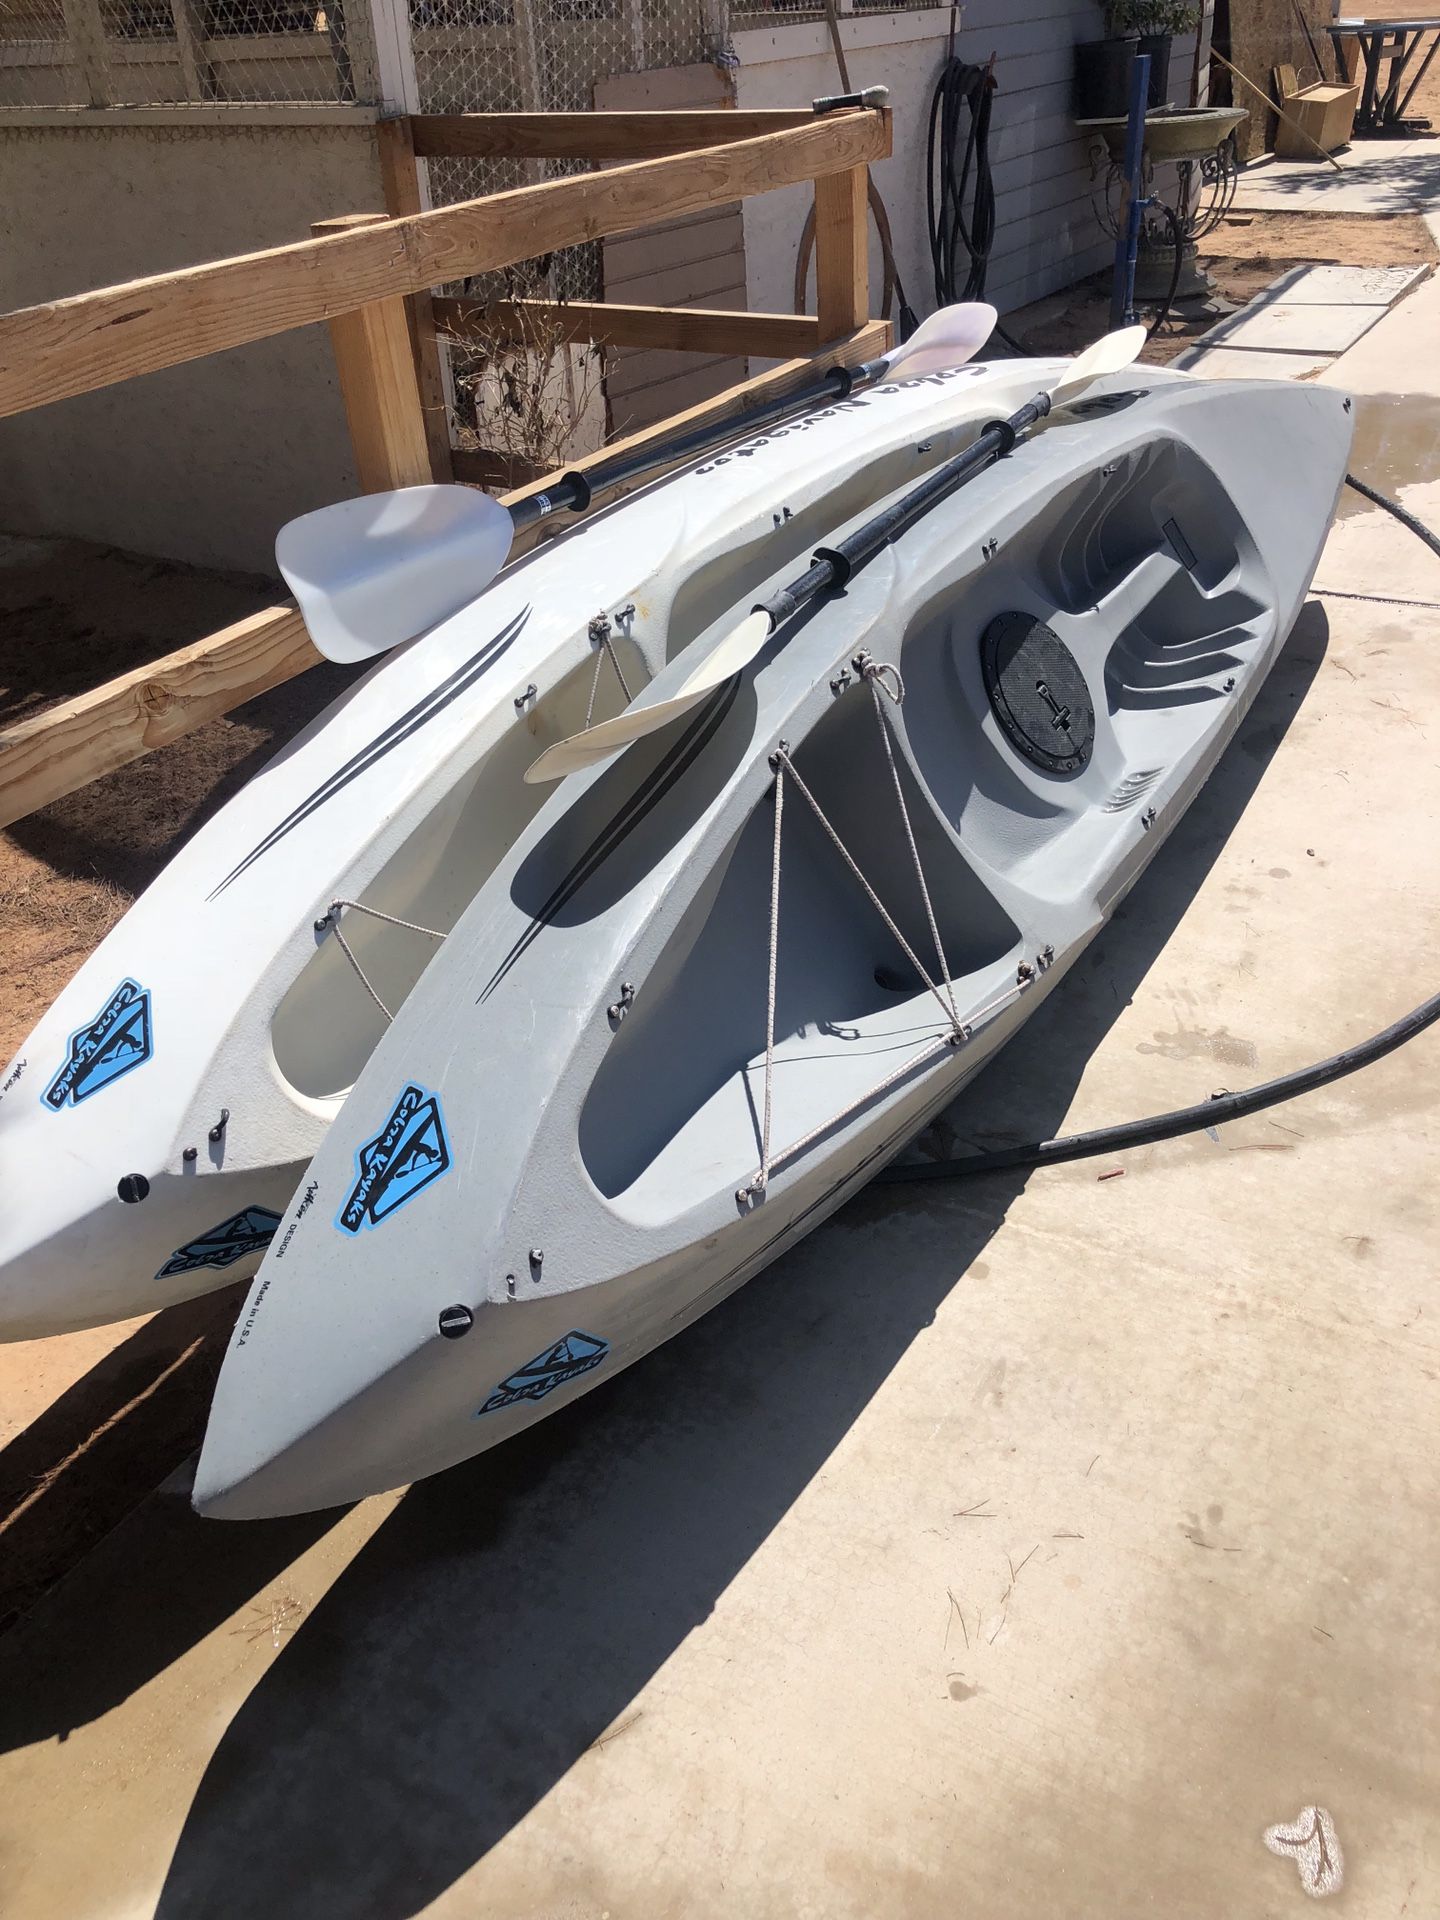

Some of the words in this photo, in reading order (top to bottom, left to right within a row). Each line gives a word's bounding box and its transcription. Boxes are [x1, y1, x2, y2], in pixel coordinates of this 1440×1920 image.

[871, 365, 989, 395] Cobra
[695, 398, 872, 475] Navigator
[94, 988, 133, 1035] Cobra
[52, 1039, 98, 1101] Kayaks
[382, 1092, 417, 1147] Cobra
[347, 1152, 389, 1223] Kayaks
[167, 1249, 226, 1272] Cobra
[276, 1224, 297, 1258] DESIGN
[249, 1307, 260, 1317] in
[254, 1280, 271, 1306] Made
[236, 1318, 255, 1349] U.S.A.
[486, 1383, 542, 1408] Cobra
[544, 1359, 597, 1388] Kayaks
